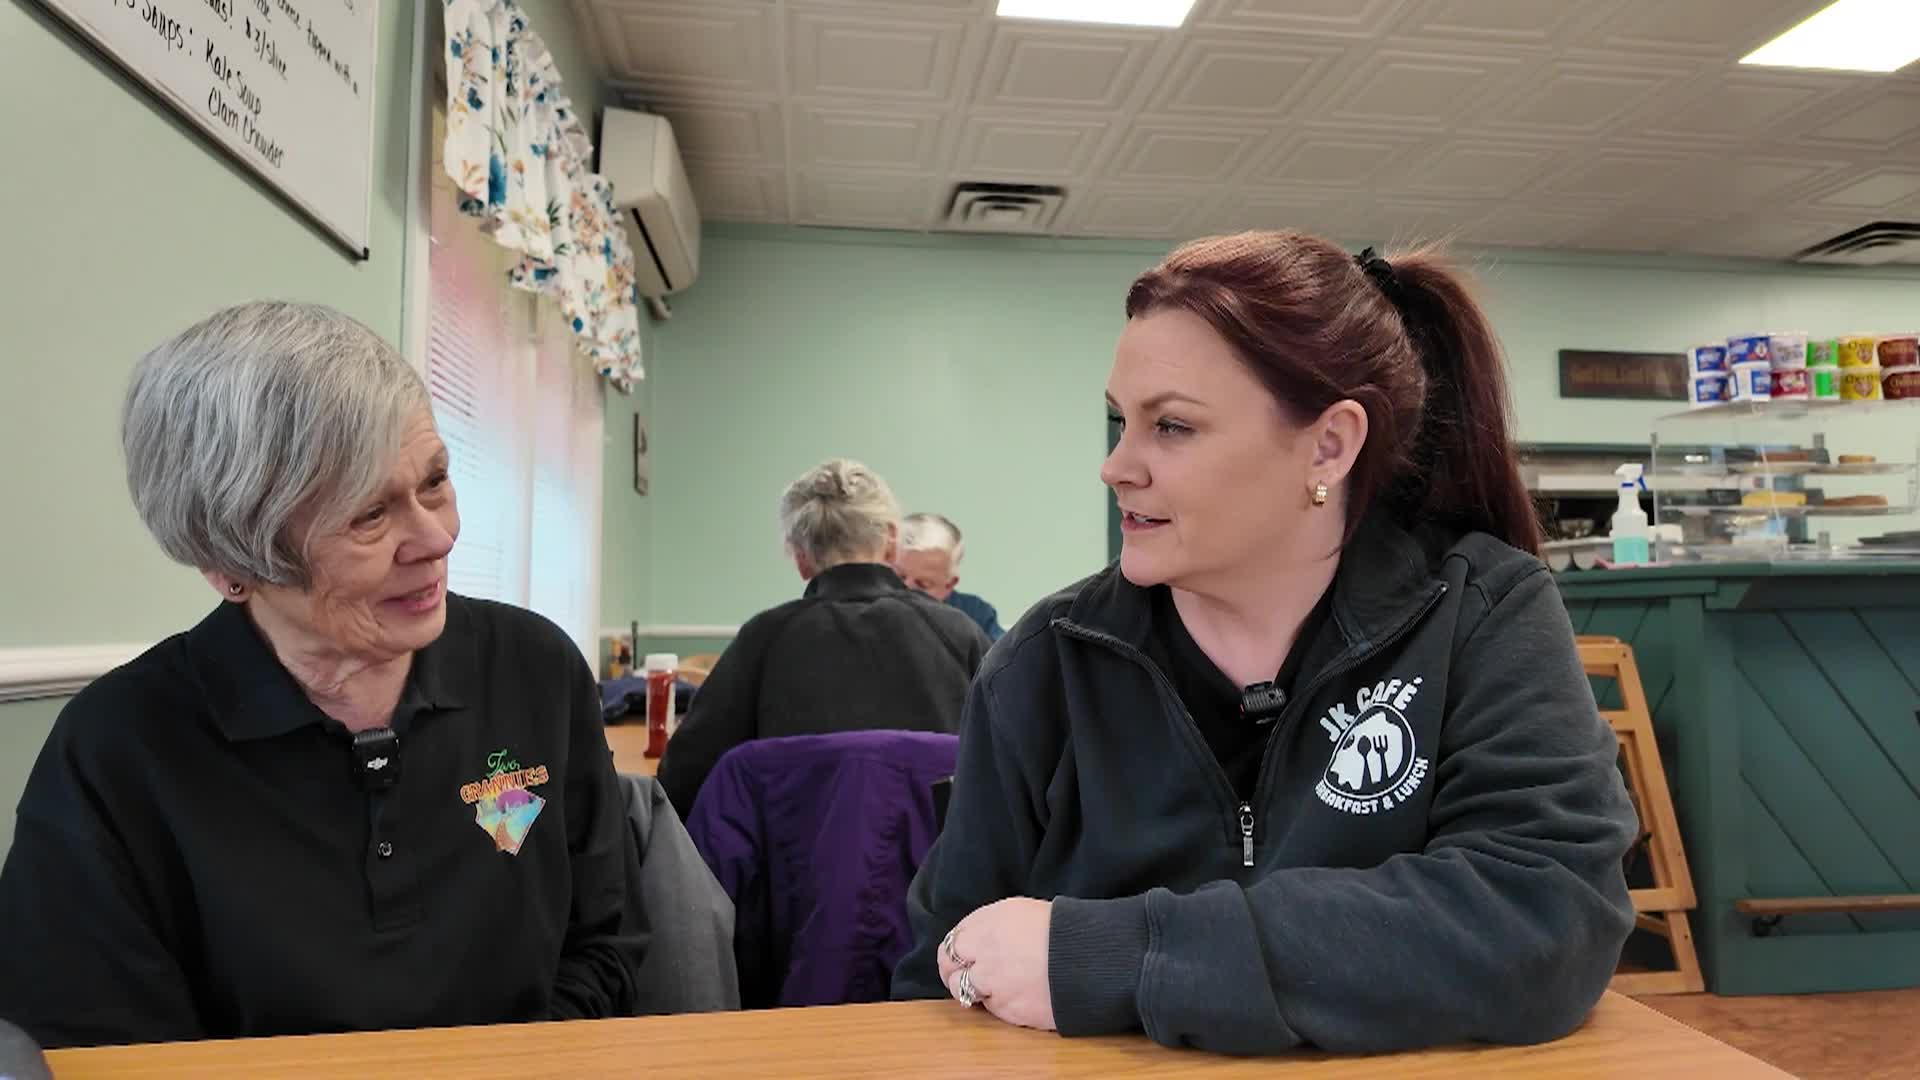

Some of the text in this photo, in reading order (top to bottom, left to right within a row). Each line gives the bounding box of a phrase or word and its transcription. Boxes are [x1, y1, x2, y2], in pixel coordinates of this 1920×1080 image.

[206, 37, 232, 89] Kale
[236, 70, 261, 122] Soup
[208, 86, 239, 132] Clam
[1318, 676, 1424, 743] JK CAFÉ
[459, 765, 550, 804] GRANNIES
[1382, 797, 1394, 810] &
[1394, 757, 1429, 802] LUNCH
